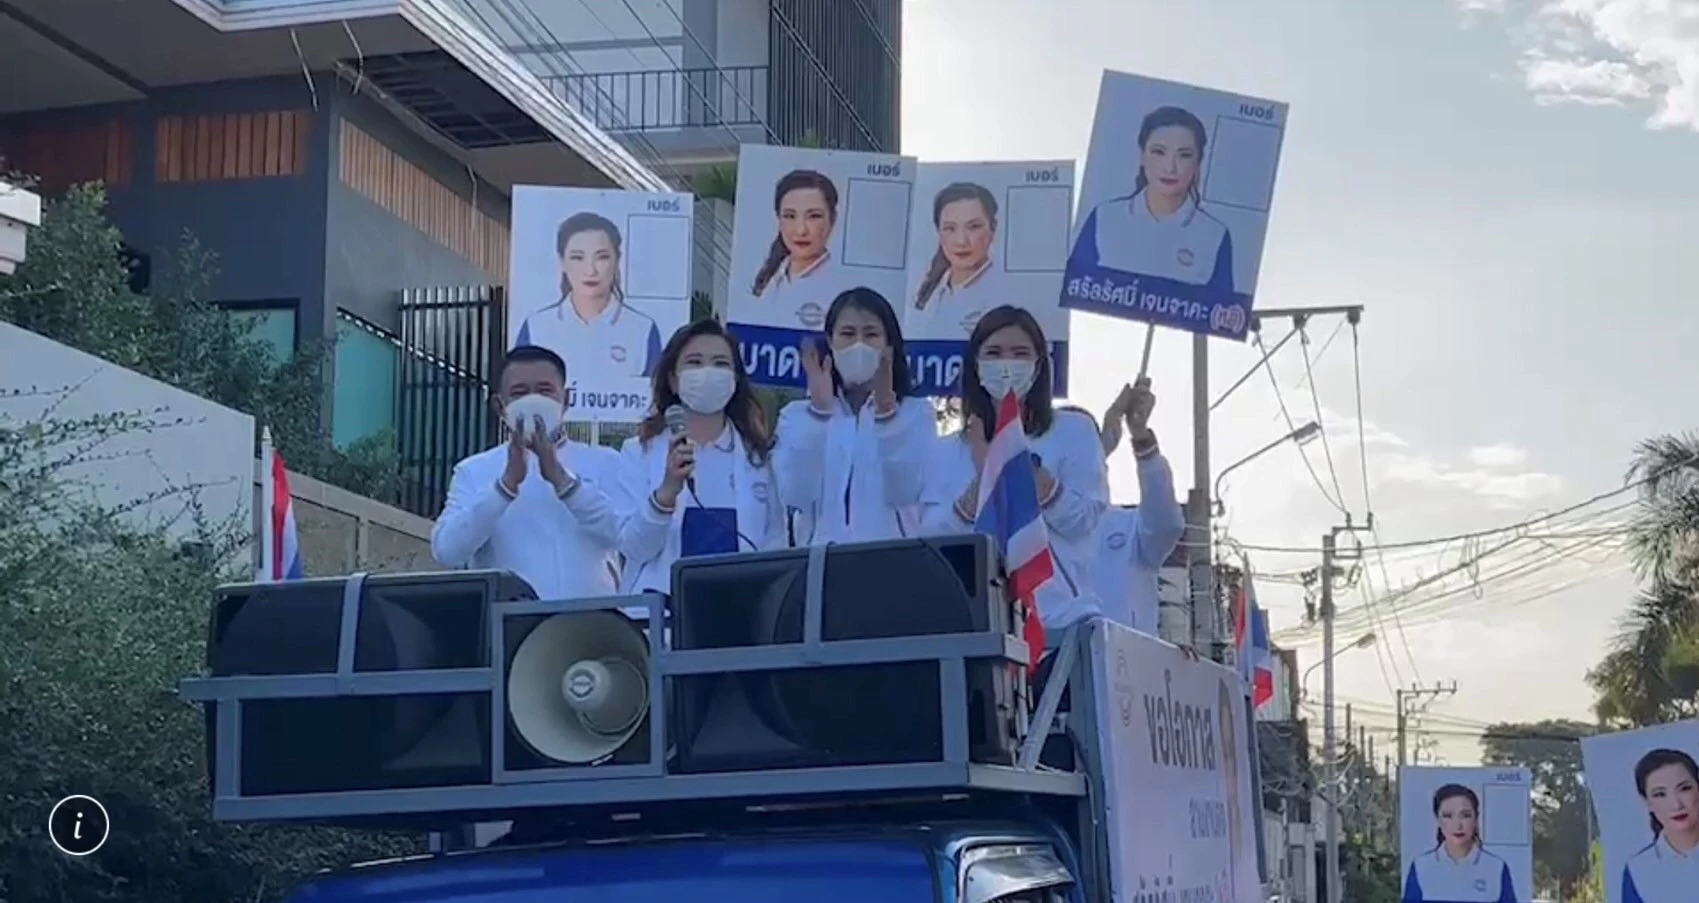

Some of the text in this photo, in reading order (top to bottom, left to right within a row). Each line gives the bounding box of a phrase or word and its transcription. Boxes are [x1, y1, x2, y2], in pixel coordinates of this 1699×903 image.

[1239, 103, 1275, 121] เบอร์
[867, 162, 902, 177] เบอร์
[1025, 167, 1060, 182] เบอร์
[647, 196, 680, 212] เบอร์
